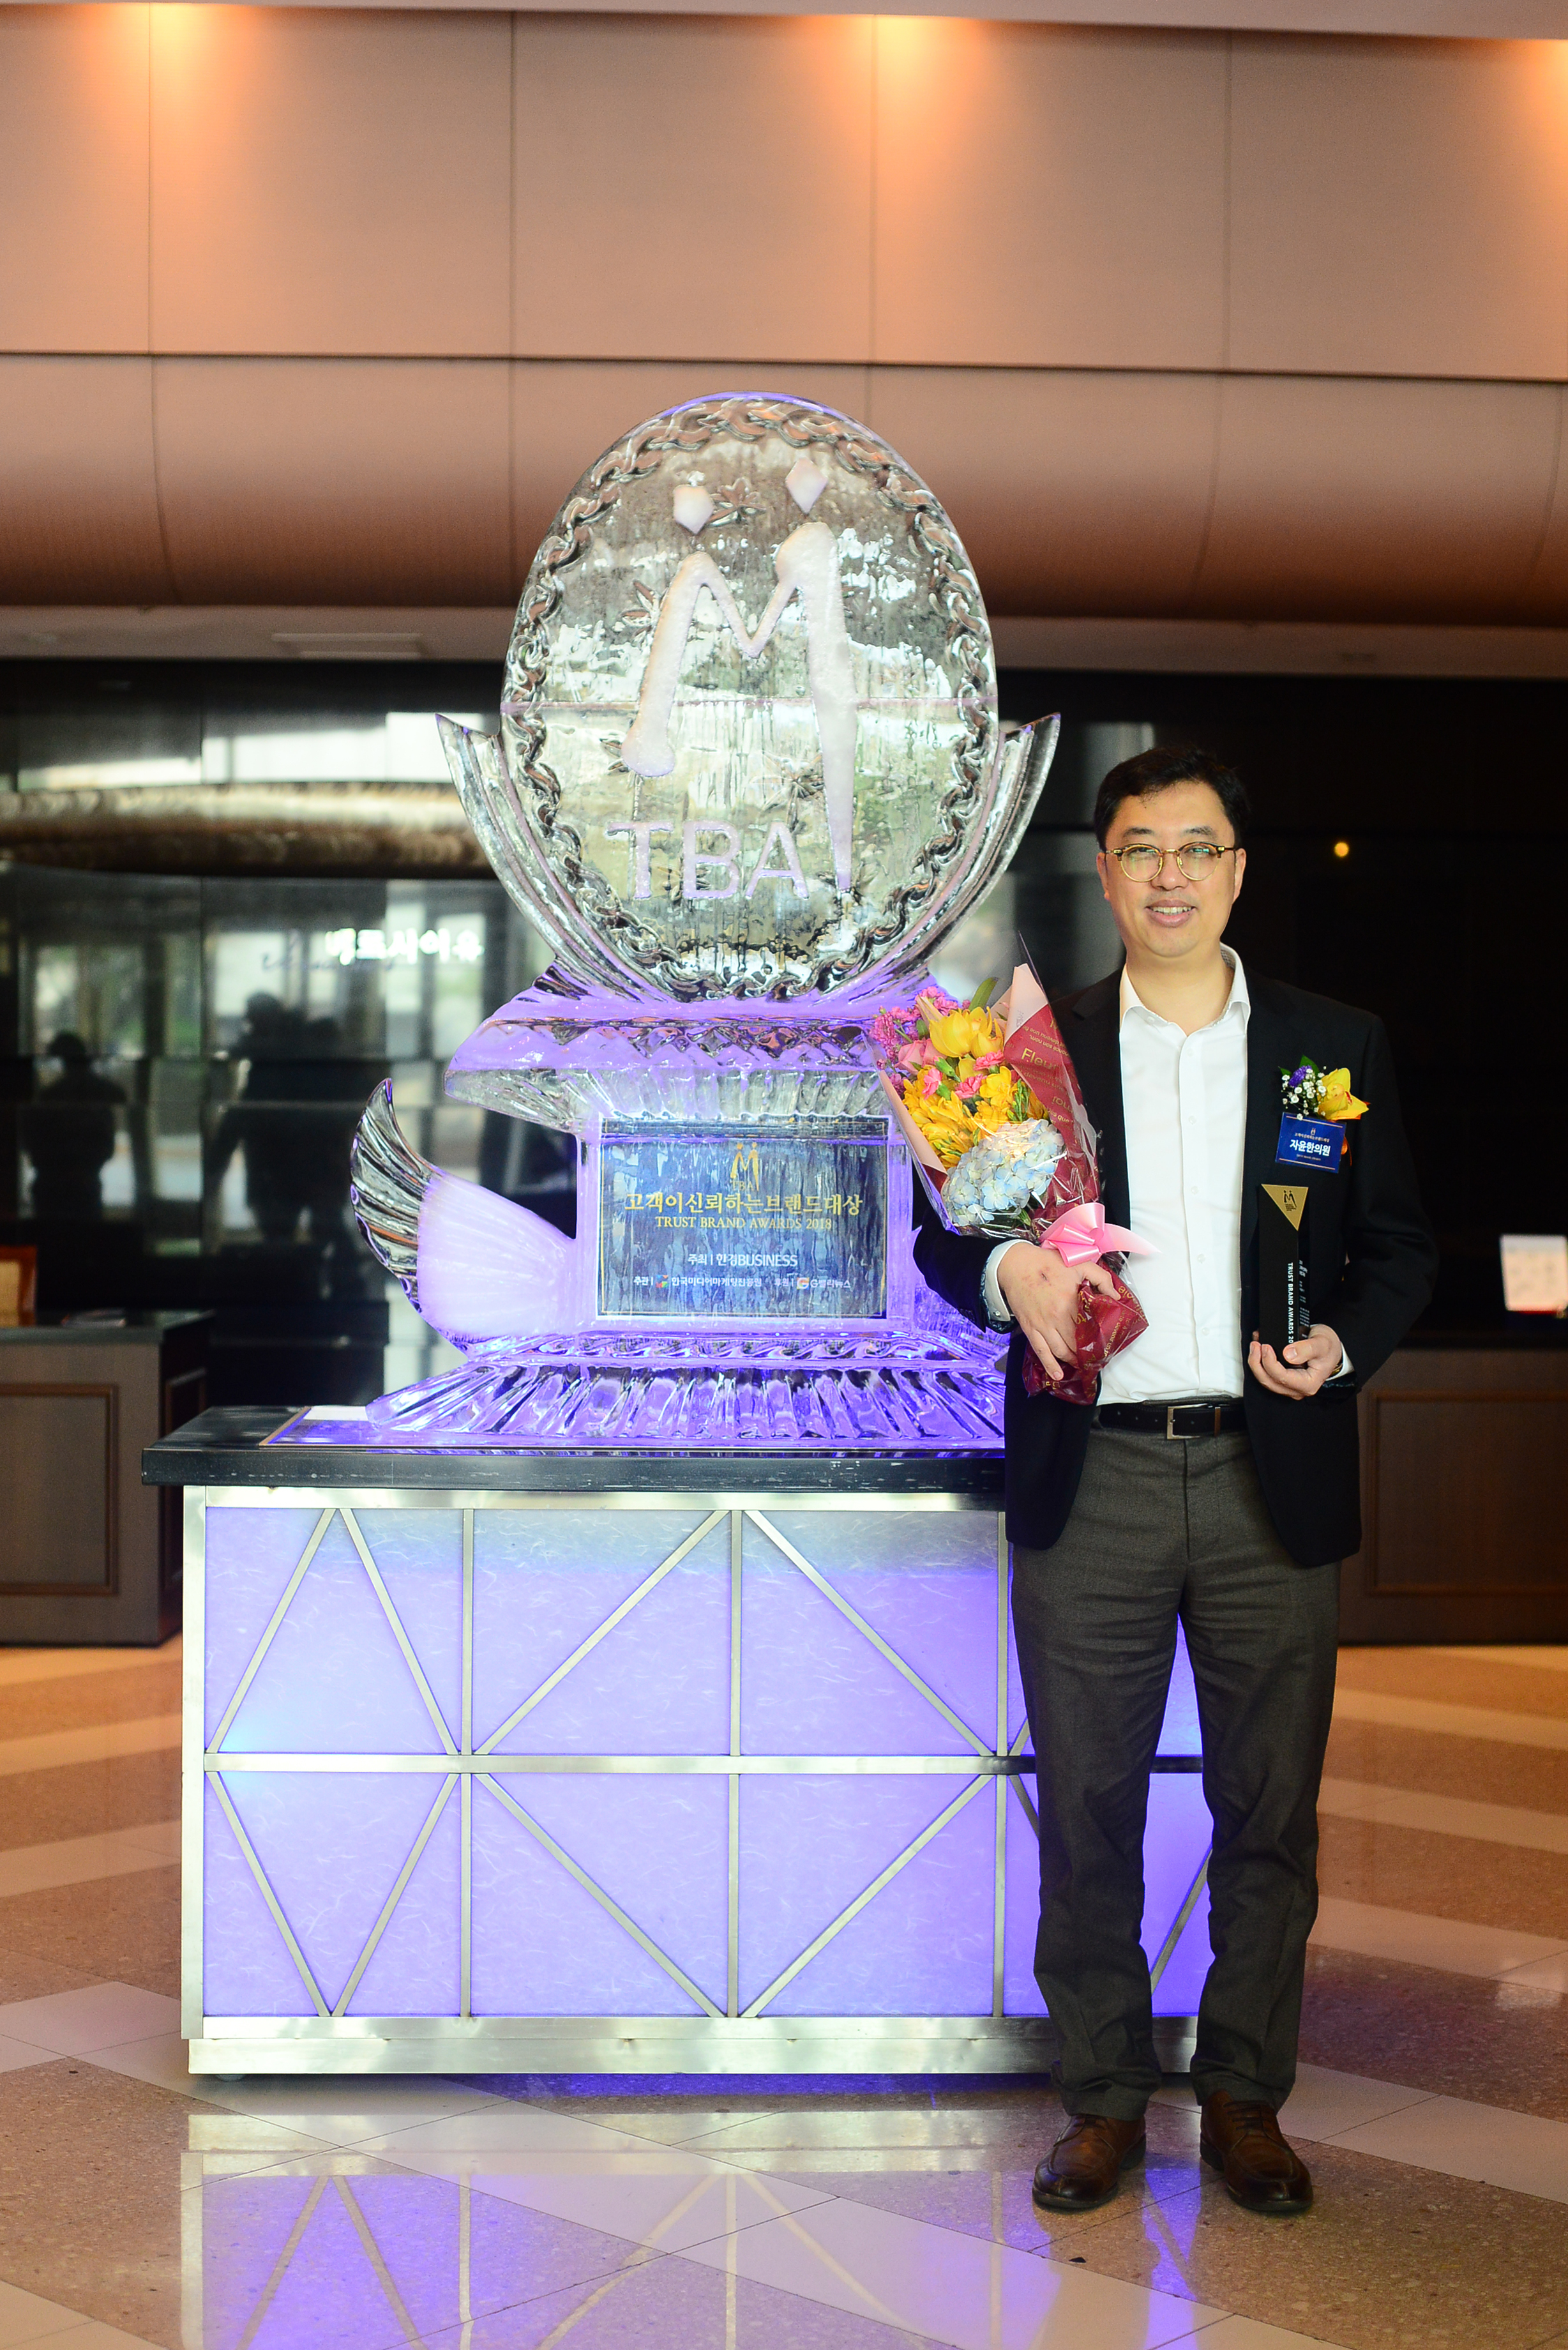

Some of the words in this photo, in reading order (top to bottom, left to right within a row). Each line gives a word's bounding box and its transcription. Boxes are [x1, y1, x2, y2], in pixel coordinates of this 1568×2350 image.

[607, 821, 810, 900] TBA
[1290, 1139, 1331, 1156] 자윤한의원
[655, 1217, 697, 1228] TRUST
[700, 1217, 746, 1229] BRAND
[750, 1218, 802, 1229] AWARDS
[806, 1218, 832, 1230] 2018
[688, 1254, 707, 1266] 주최
